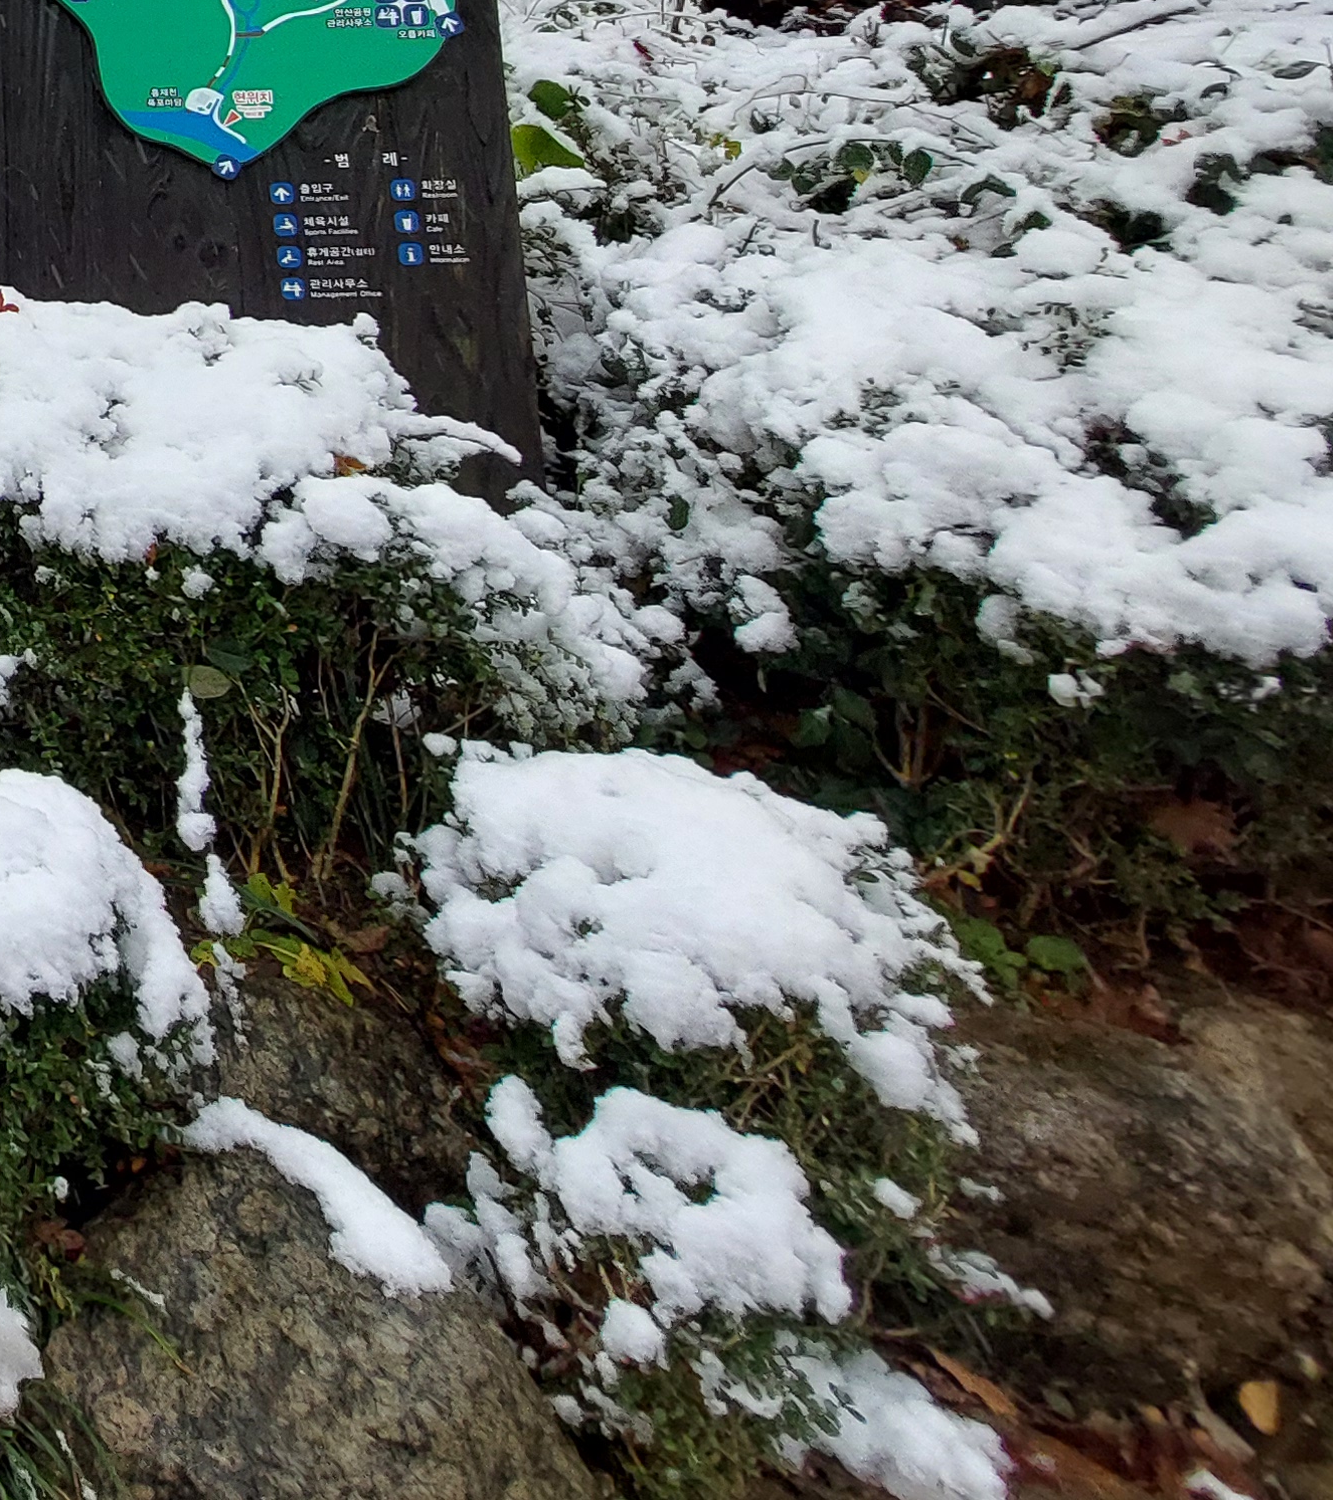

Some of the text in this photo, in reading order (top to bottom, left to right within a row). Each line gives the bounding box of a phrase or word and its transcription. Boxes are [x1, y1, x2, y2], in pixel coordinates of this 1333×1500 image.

[327, 19, 373, 28] 관리사무소
[234, 91, 272, 104] 현위치
[299, 184, 334, 194] 출입구
[421, 180, 457, 191] 화장실
[422, 191, 458, 199] Restroom
[303, 216, 349, 227] 체육시설
[425, 214, 450, 224] 카페
[328, 227, 358, 235] Facilities
[426, 225, 444, 233] Cafe
[306, 246, 375, 257] 휴게공간(쉼터)
[429, 245, 465, 255] 안내소
[307, 258, 345, 266] Rest Area
[309, 279, 368, 289] 관리사무소
[359, 290, 383, 298] Office
